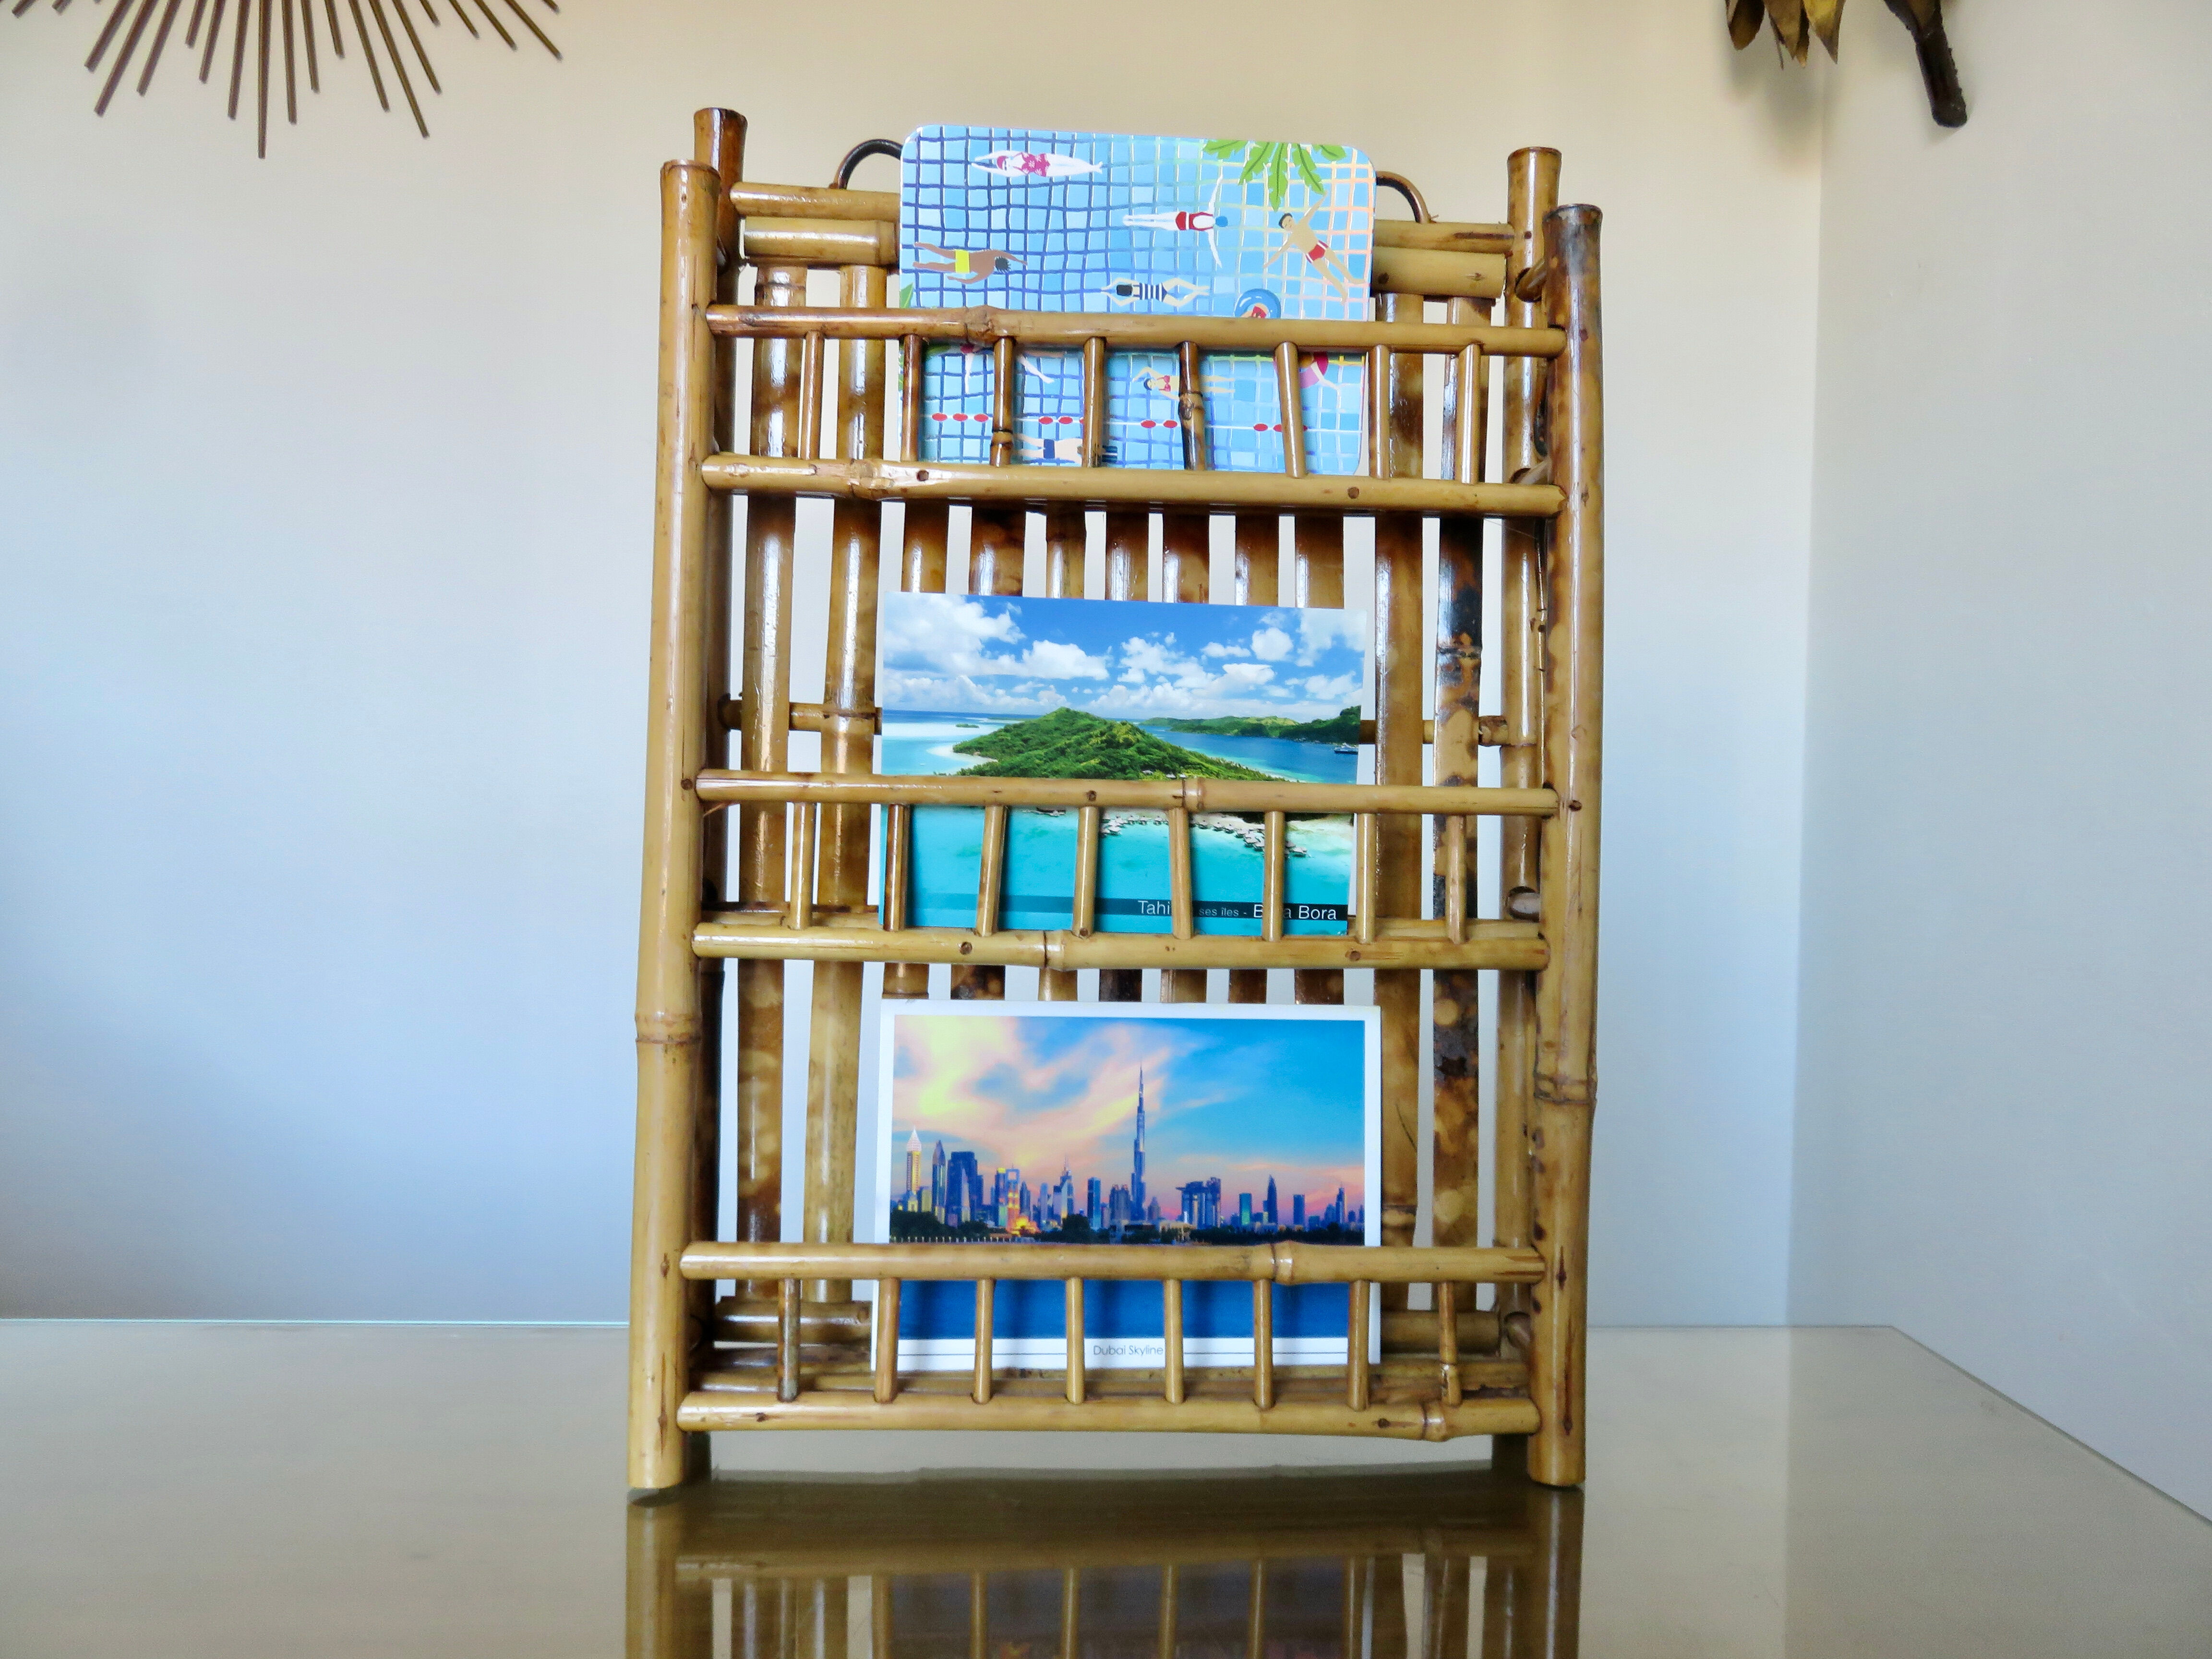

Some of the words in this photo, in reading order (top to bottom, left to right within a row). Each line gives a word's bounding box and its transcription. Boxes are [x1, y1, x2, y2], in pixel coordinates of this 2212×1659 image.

[1138, 901, 1171, 915] Tahi
[1253, 904, 1292, 919] Ba
[1298, 905, 1336, 920] Bora
[1094, 1345, 1126, 1355] Dubai
[1129, 1345, 1164, 1356] Skyline
